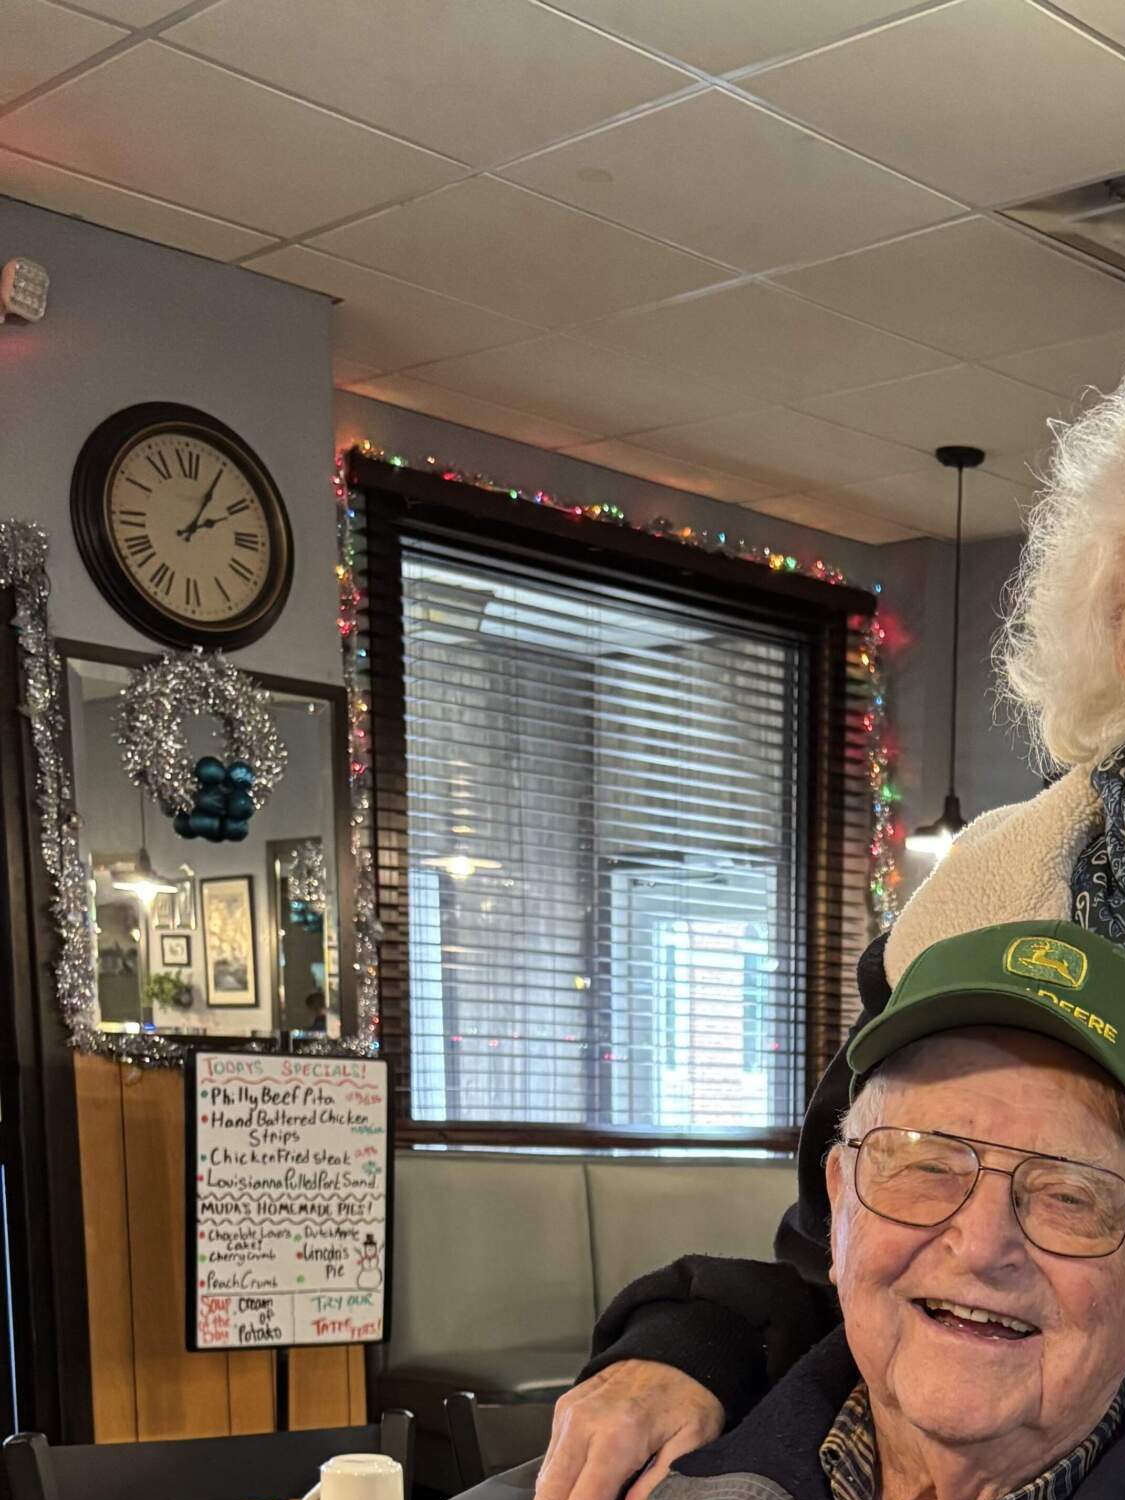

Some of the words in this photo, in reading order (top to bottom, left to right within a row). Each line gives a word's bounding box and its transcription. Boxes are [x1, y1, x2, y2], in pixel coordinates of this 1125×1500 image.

[281, 1059, 366, 1079] SPECIALS!
[211, 1086, 258, 1112] Philly
[261, 1086, 299, 1106] Beef
[304, 1088, 335, 1106] Pita
[211, 1110, 252, 1128] Hand
[257, 1110, 317, 1127] Battered
[320, 1110, 368, 1127] Chicken
[249, 1129, 300, 1147] Strips
[210, 1147, 276, 1166] Chicken
[277, 1149, 310, 1164] Fried
[284, 1167, 317, 1190] Pulled
[319, 1170, 340, 1190] Pork
[342, 1171, 376, 1189] Sand
[257, 1200, 332, 1217] HOMEMADE
[338, 1201, 372, 1217] PIES!
[208, 1227, 257, 1241] Chocolate
[209, 1251, 245, 1267] Cherry
[207, 1270, 239, 1290] Peach
[238, 1323, 282, 1344] Potato
